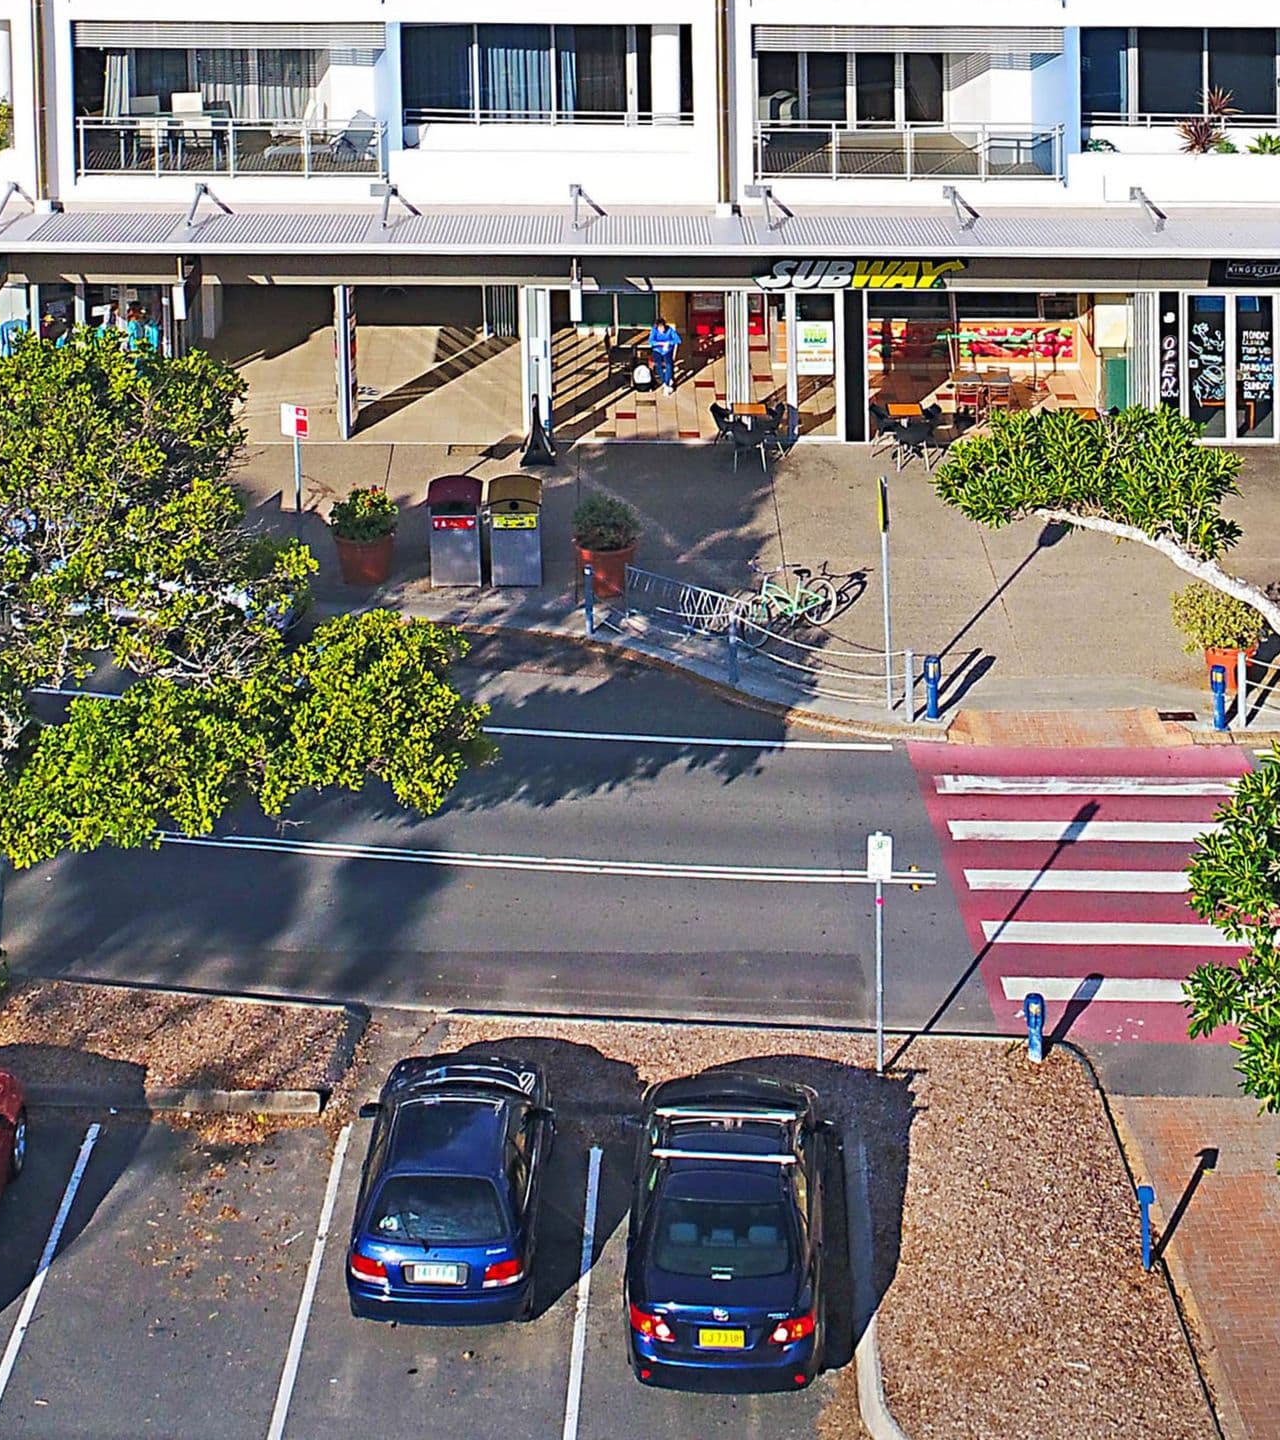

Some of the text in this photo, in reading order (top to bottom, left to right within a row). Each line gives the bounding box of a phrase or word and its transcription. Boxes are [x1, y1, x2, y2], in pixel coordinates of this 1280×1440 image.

[754, 259, 966, 290] SUBWAY
[1162, 336, 1176, 390] OPEN
[1243, 381, 1270, 391] SUNDAY
